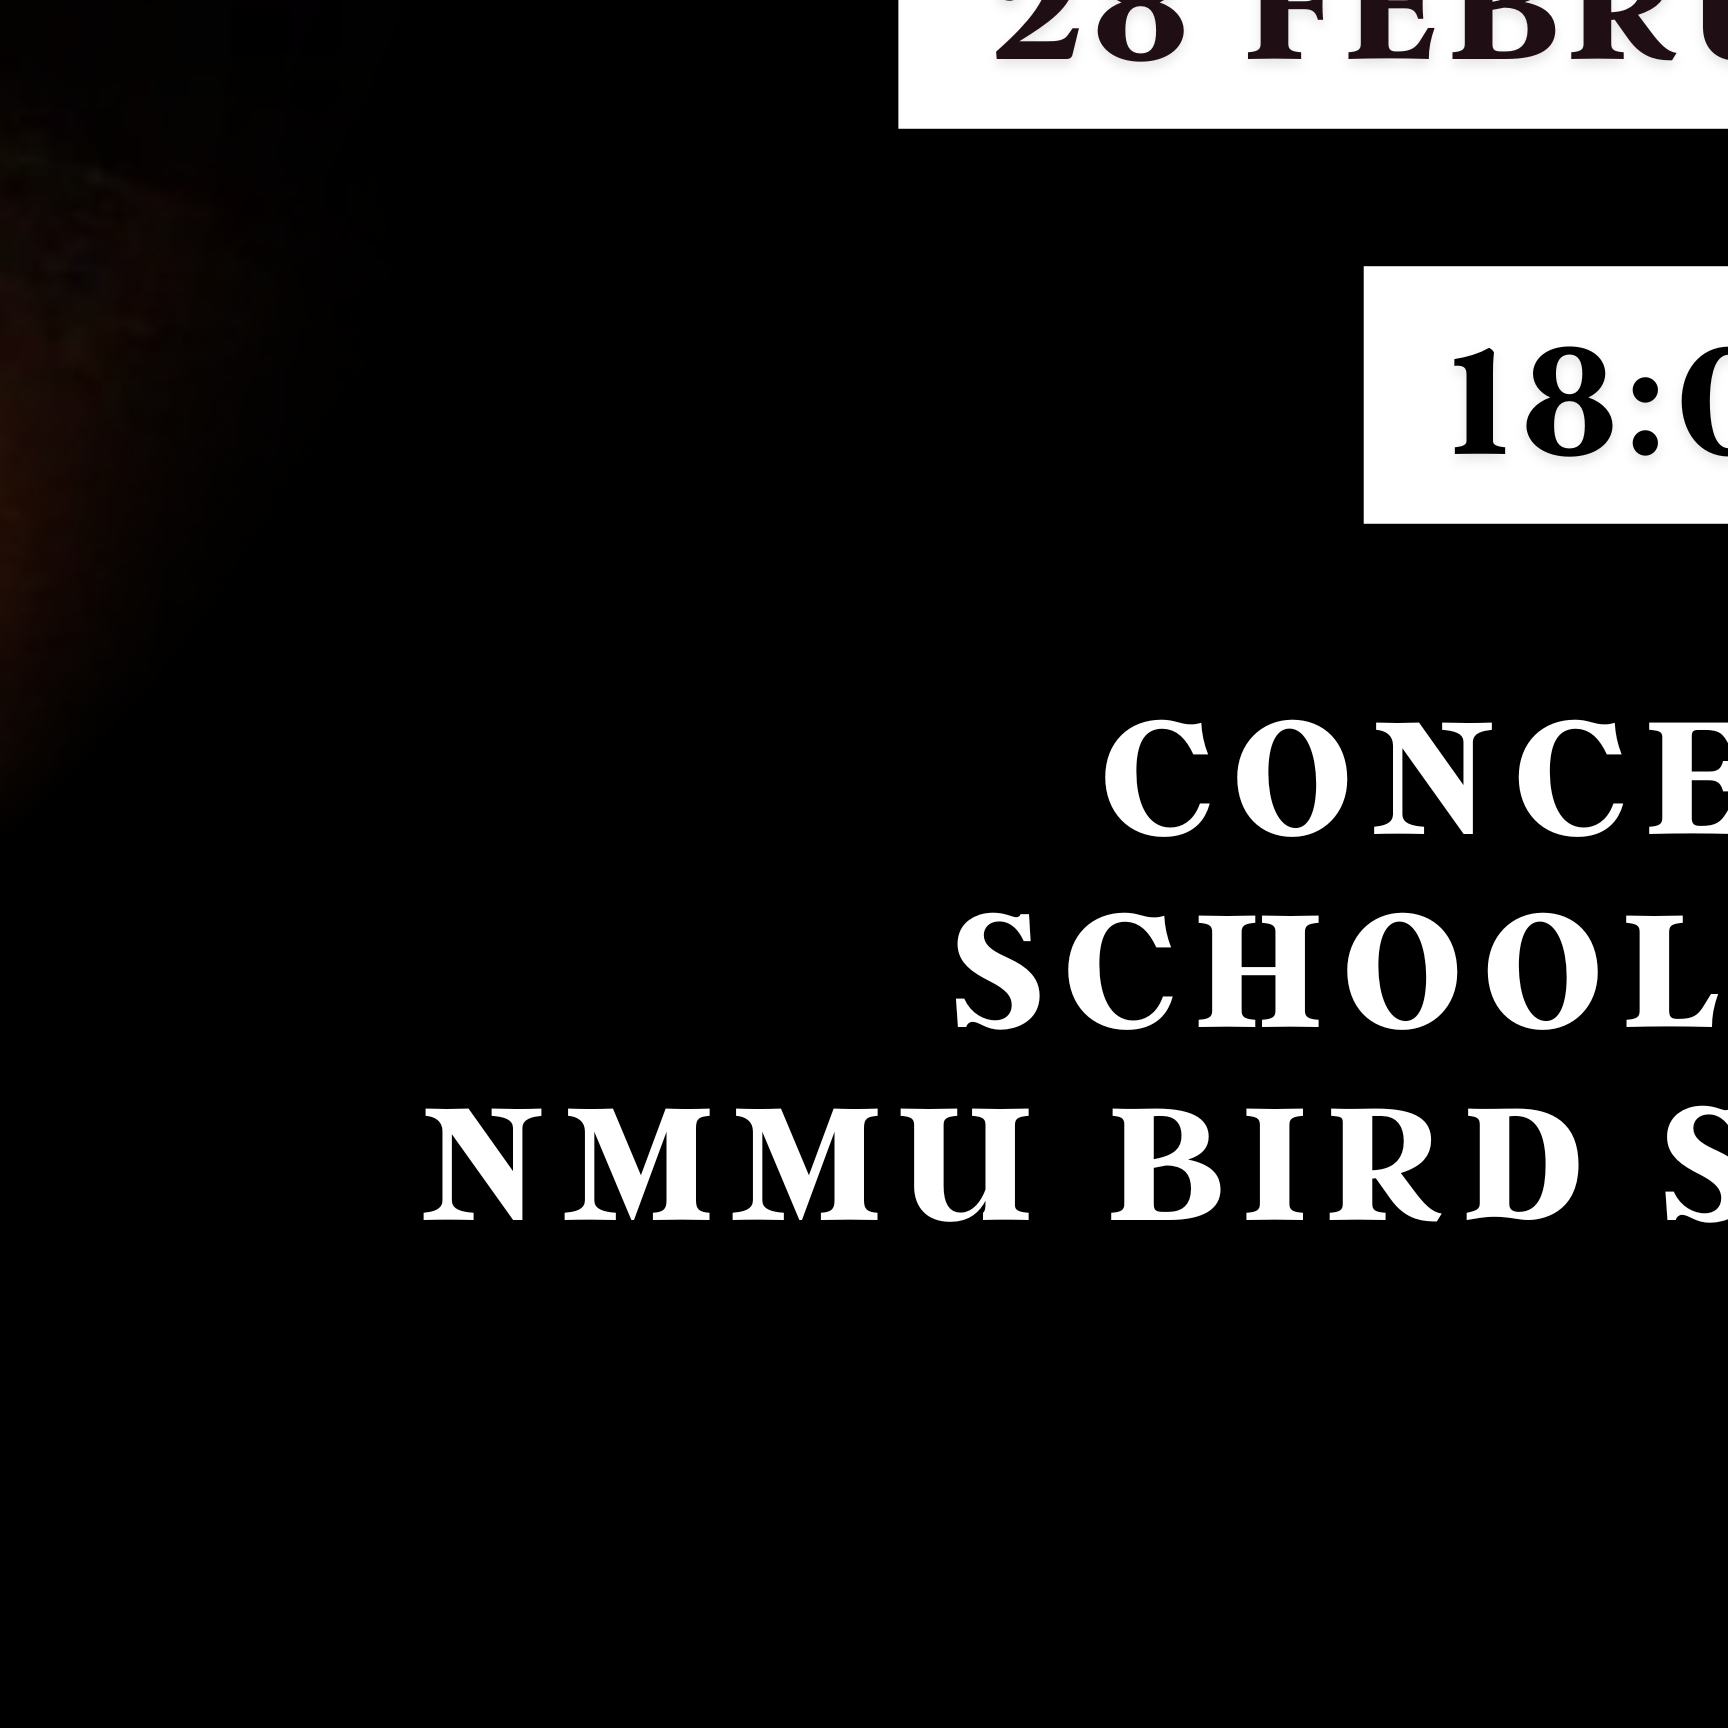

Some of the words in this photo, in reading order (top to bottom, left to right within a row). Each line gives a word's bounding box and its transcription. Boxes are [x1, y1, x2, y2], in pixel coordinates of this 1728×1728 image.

[954, 911, 1719, 1031] SCHOOL
[422, 1104, 1030, 1224] NMMU
[1109, 1104, 1579, 1224] BIRD
